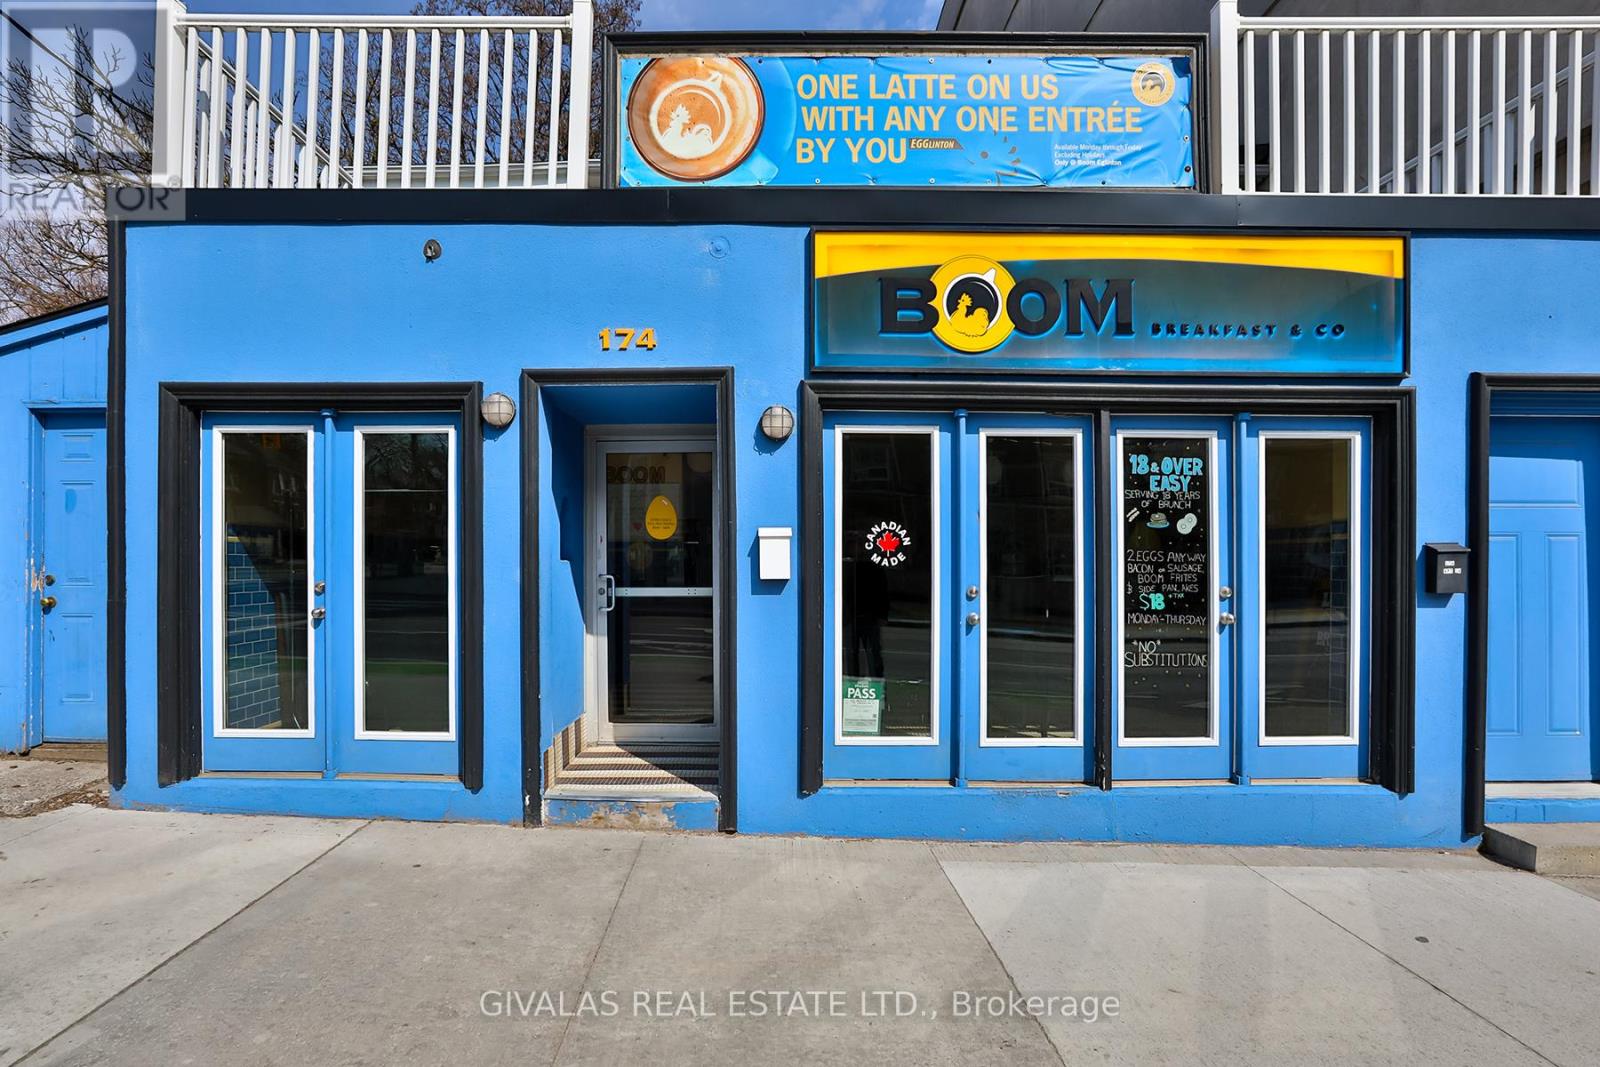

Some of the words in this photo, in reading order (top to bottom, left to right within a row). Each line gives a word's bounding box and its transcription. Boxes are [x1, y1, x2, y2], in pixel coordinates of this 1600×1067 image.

[797, 74, 858, 100] ONE
[869, 74, 956, 100] LATTE
[967, 74, 1010, 100] ON
[1022, 74, 1059, 100] US
[801, 106, 873, 132] WITH
[884, 106, 946, 132] ANY
[956, 106, 1018, 132] ONE
[1028, 101, 1143, 133] ENTRÉE
[795, 138, 834, 164] BY
[844, 138, 907, 164] YOU
[1055, 143, 1079, 151] Available
[1080, 143, 1102, 152] Monday
[1055, 152, 1080, 160] Excluding
[1055, 159, 1069, 167] Only
[878, 256, 1136, 352] BOOM
[1151, 322, 1277, 337] BREAKFAST
[1290, 323, 1302, 337] &
[1315, 323, 1346, 337] CO
[599, 327, 657, 351] 174
[1129, 454, 1150, 474] 18
[1150, 462, 1160, 473] &
[1161, 457, 1203, 476] OVER
[1150, 475, 1191, 492] EASY
[1124, 489, 1159, 500] SERVING
[1174, 491, 1201, 500] YEARS
[1141, 500, 1152, 508] OF
[1158, 500, 1191, 509] BRUNCH
[865, 521, 911, 550] CANADIAN
[870, 552, 907, 567] MADE
[1127, 563, 1154, 573] BACON
[1137, 573, 1164, 584] BOOM
[1170, 573, 1198, 582] FRITES
[1138, 585, 1157, 593] SIDE
[1124, 652, 1208, 667] SUBSTITUTIONS
[847, 687, 876, 699] PASS
